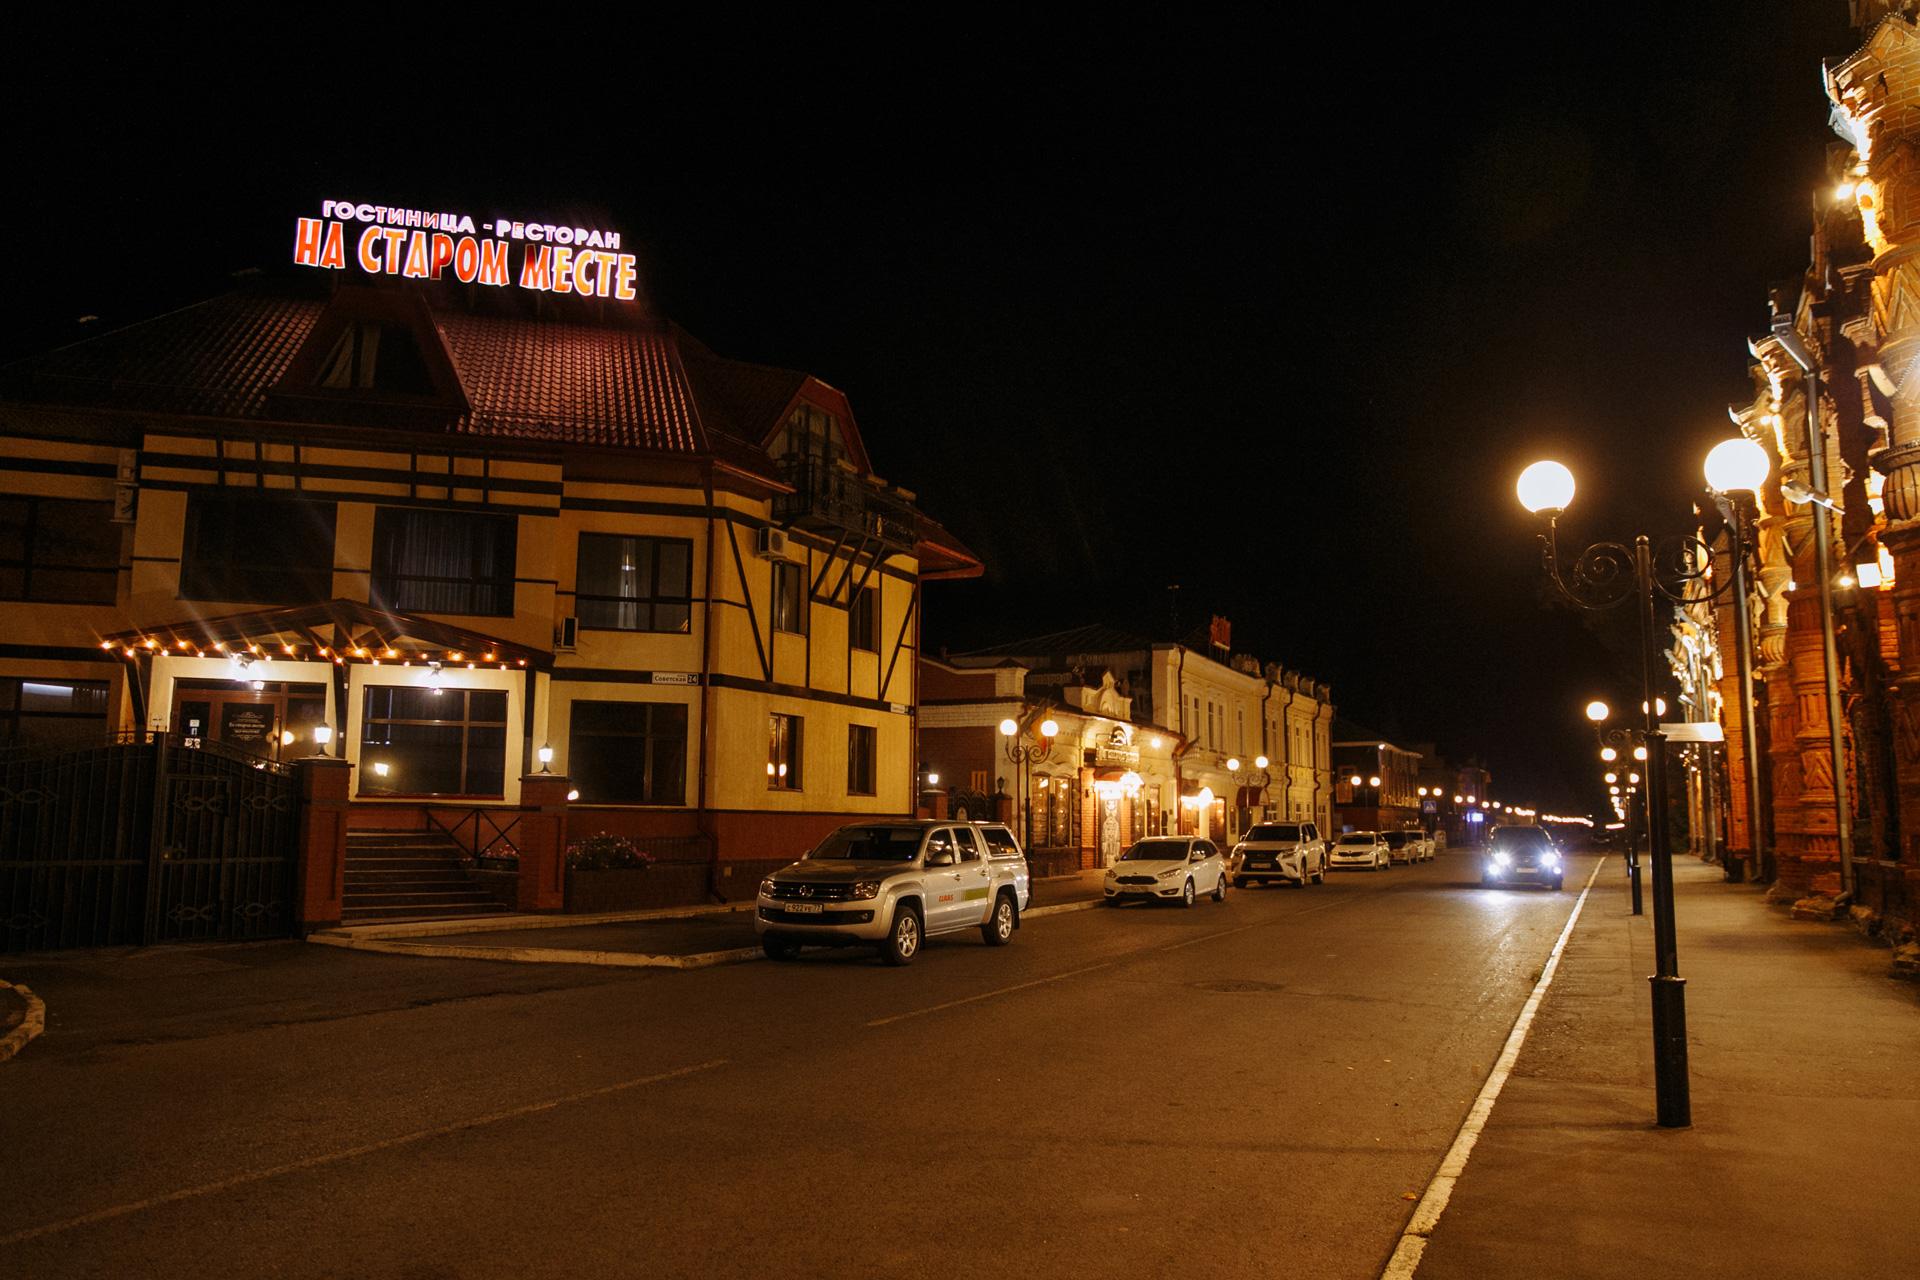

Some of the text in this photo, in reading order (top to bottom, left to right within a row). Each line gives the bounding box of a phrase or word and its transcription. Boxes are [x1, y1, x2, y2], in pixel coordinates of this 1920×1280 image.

[322, 200, 476, 234] ГОСТИНИЦА
[294, 216, 637, 300] НА СТАРОМ МЕСТЕ
